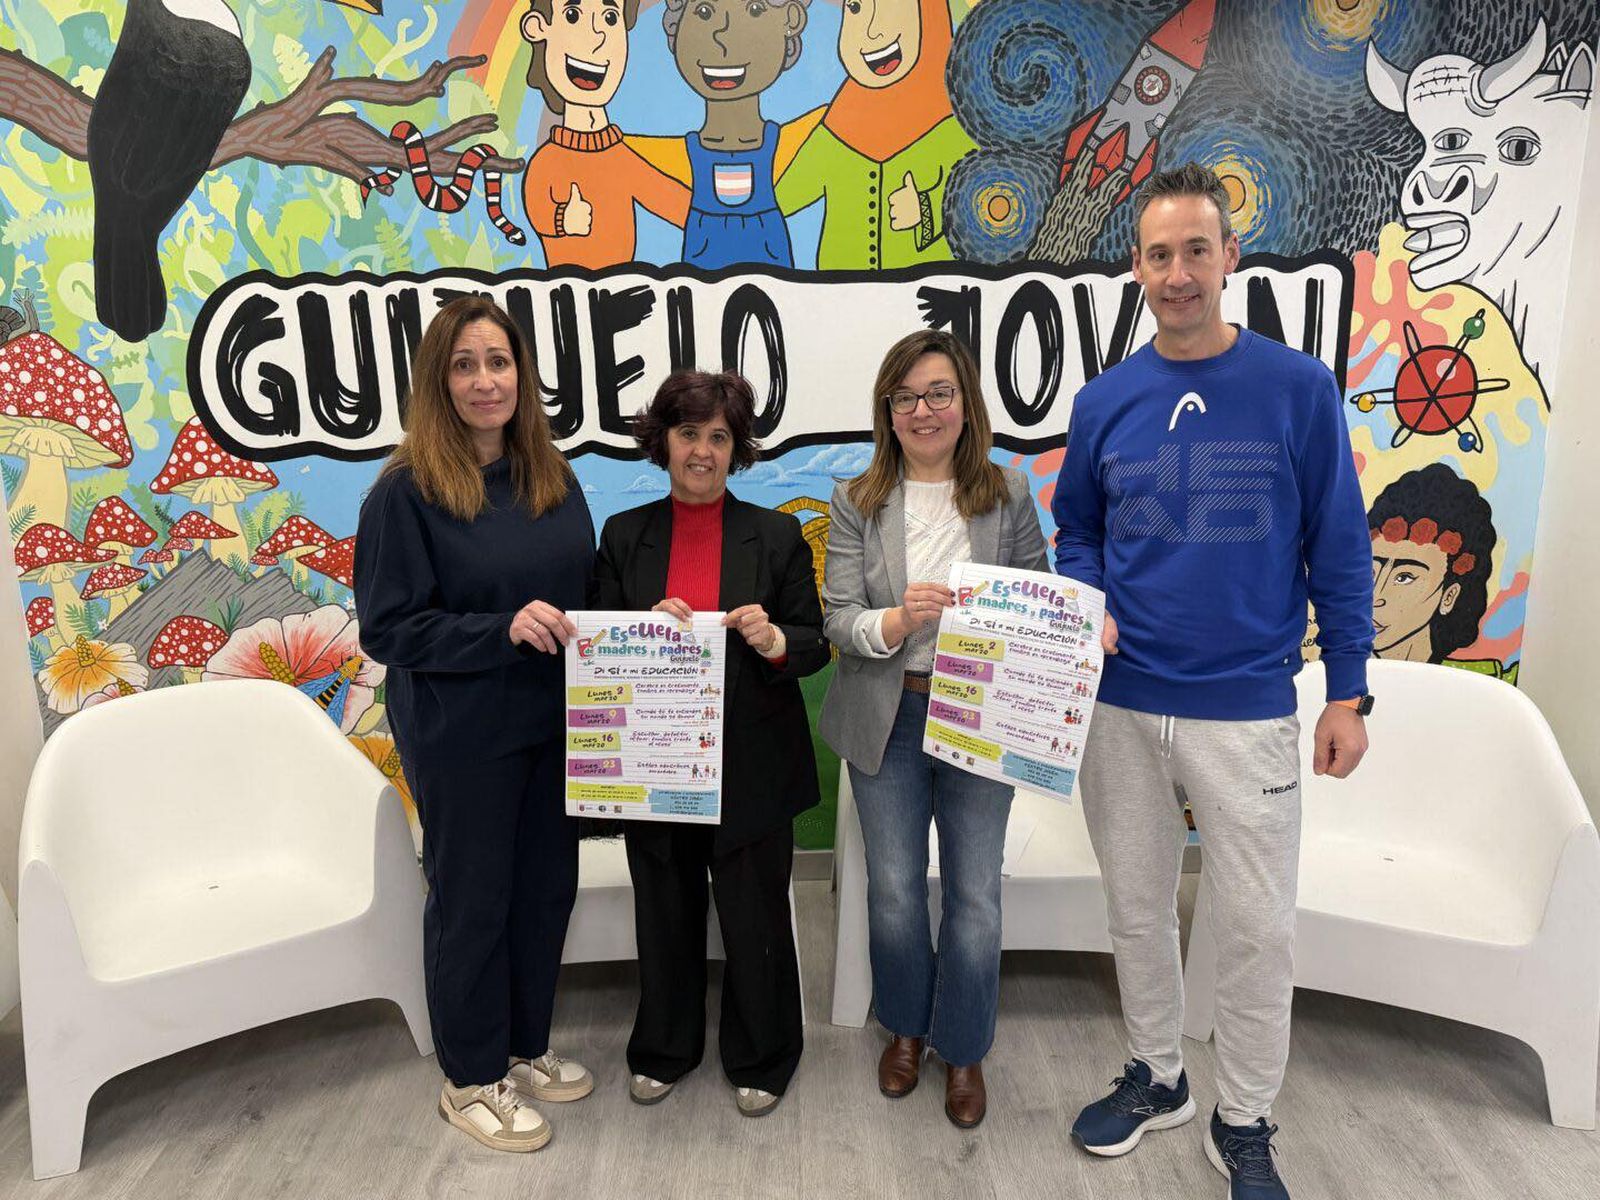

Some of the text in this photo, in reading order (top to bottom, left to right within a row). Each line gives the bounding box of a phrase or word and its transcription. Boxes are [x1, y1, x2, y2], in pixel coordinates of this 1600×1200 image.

[991, 579, 1066, 608] Escuela
[977, 595, 1028, 613] madres
[1039, 607, 1084, 625] padres
[1050, 619, 1080, 632] Guijuelo
[610, 622, 682, 643] Escuela
[1017, 626, 1078, 645] EDUCACIÓN
[598, 643, 648, 655] madres
[660, 644, 702, 656] padres
[958, 640, 996, 650] Lunes 2
[964, 647, 989, 655] marzo
[641, 666, 698, 675] EDUCACIÓN
[947, 661, 985, 672] Lunes 9
[953, 668, 977, 677] marzo
[587, 686, 624, 698] Lunes 2
[938, 681, 977, 695] Lunes 16
[946, 689, 968, 699] marzo
[580, 712, 605, 720] Lunes
[935, 706, 976, 720] Lunes 23
[602, 733, 614, 742] 16
[602, 760, 615, 768] 23
[1262, 780, 1298, 795] HEAD
